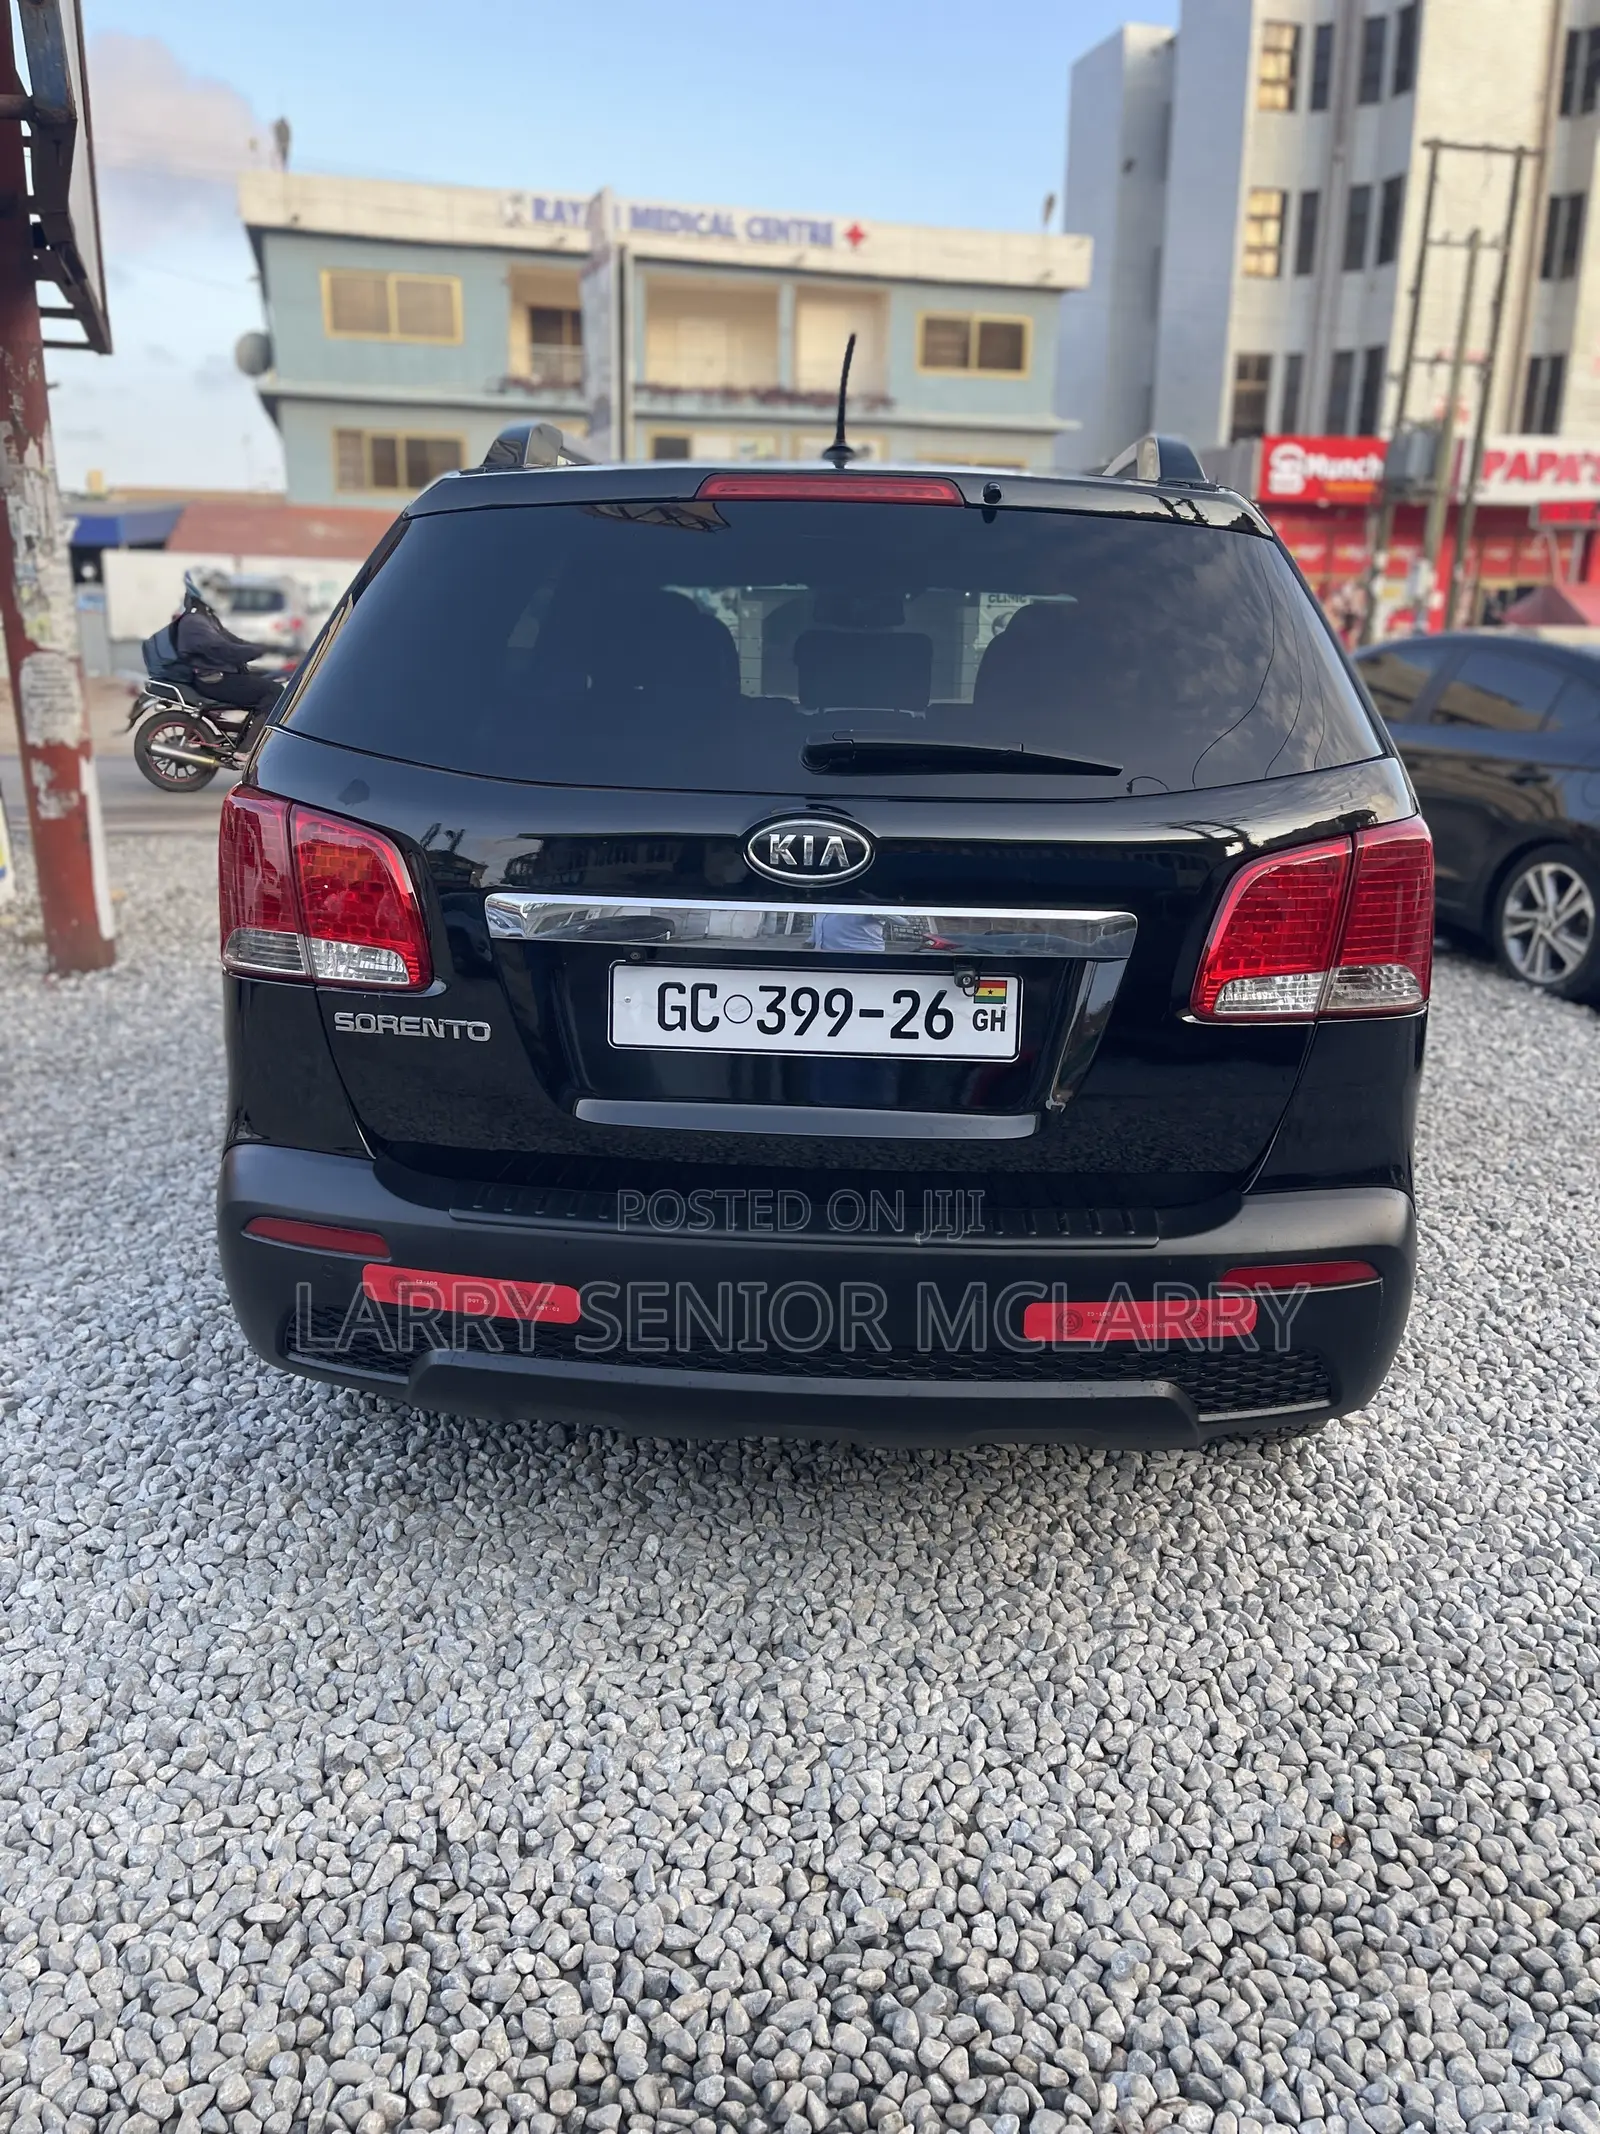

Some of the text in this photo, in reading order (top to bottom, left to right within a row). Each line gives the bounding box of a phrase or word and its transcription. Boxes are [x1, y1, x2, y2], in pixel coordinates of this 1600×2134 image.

[532, 197, 621, 226] RAY
[630, 206, 736, 238] MEDICAL
[1306, 452, 1384, 481] Munch
[769, 833, 850, 867] KIA
[334, 1011, 492, 1042] SORENTO
[972, 1008, 1006, 1032] GH
